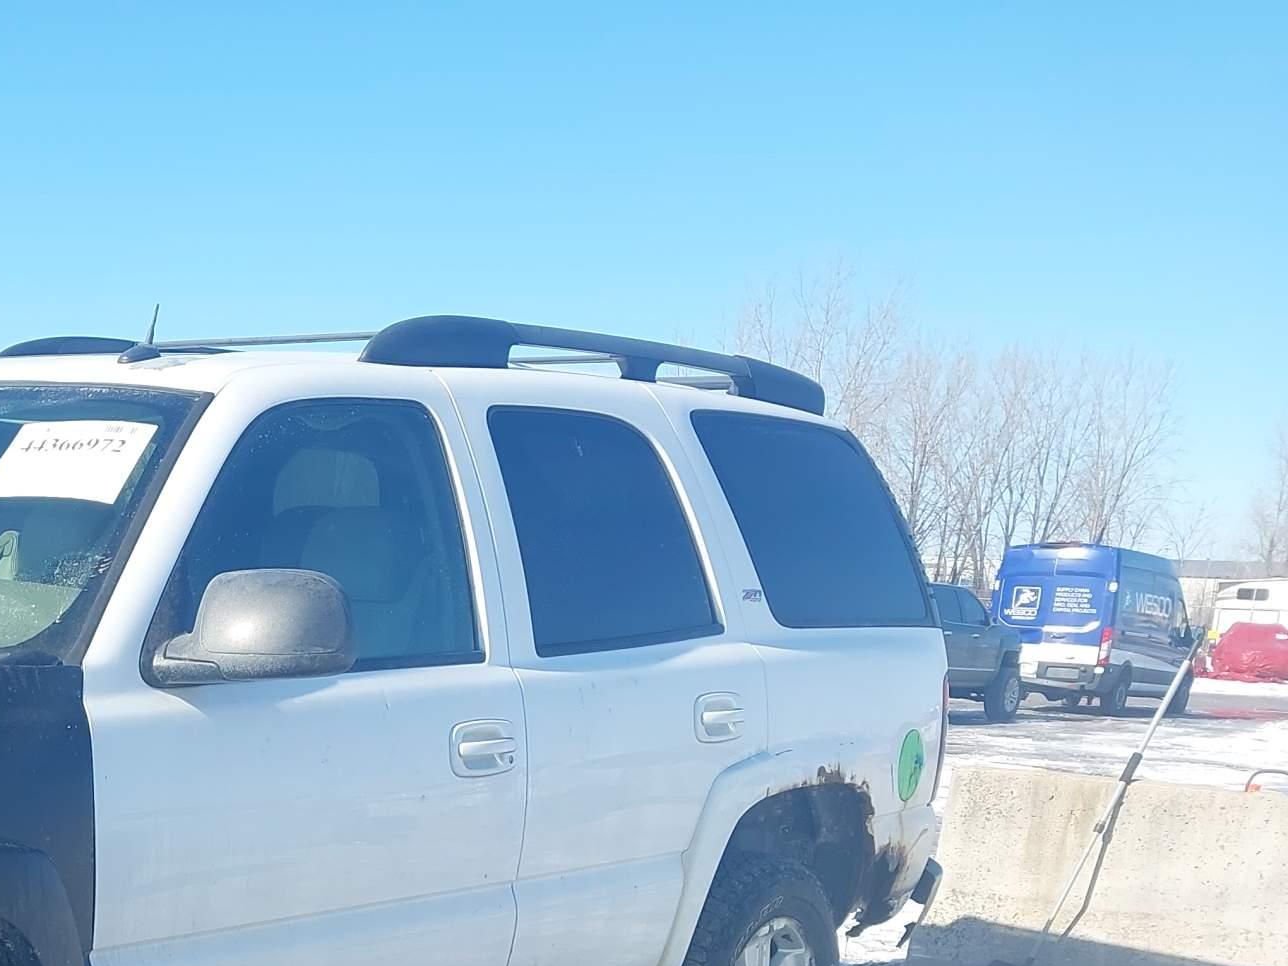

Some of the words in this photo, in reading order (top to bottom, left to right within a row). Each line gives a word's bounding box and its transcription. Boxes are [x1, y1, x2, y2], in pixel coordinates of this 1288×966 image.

[20, 439, 127, 453] 44366972
[1003, 608, 1038, 616] WESCO
[1136, 592, 1172, 618] WESCO
